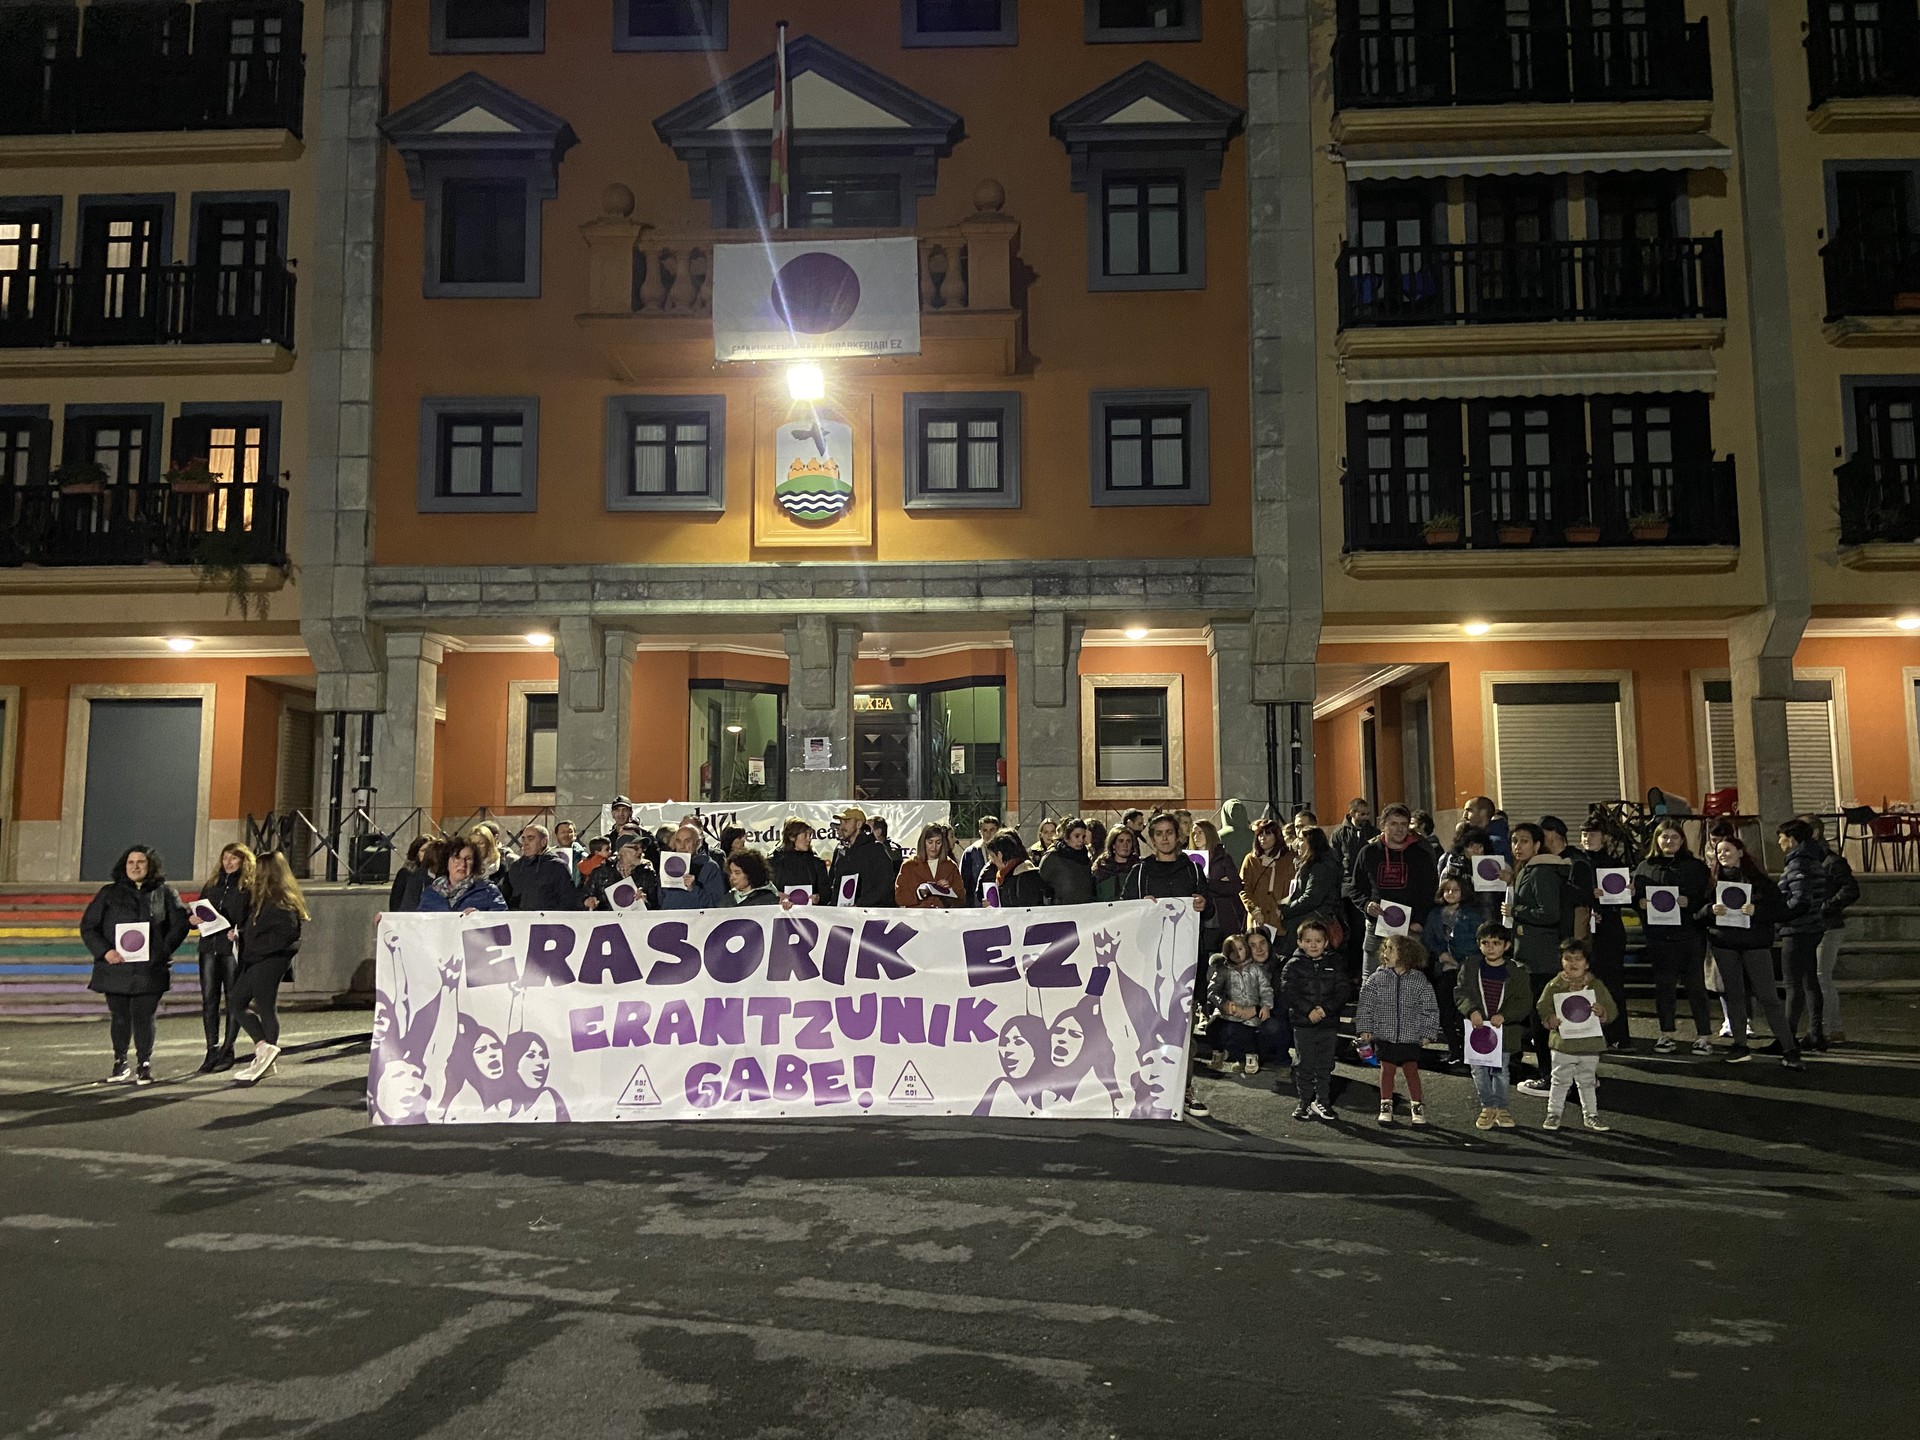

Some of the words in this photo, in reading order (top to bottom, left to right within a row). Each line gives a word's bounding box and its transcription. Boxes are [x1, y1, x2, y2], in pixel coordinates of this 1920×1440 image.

[890, 339, 903, 349] EZ
[462, 917, 919, 988] ERASORIK
[568, 992, 999, 1052] ERANTZUNIK
[684, 1054, 876, 1109] GABE!
